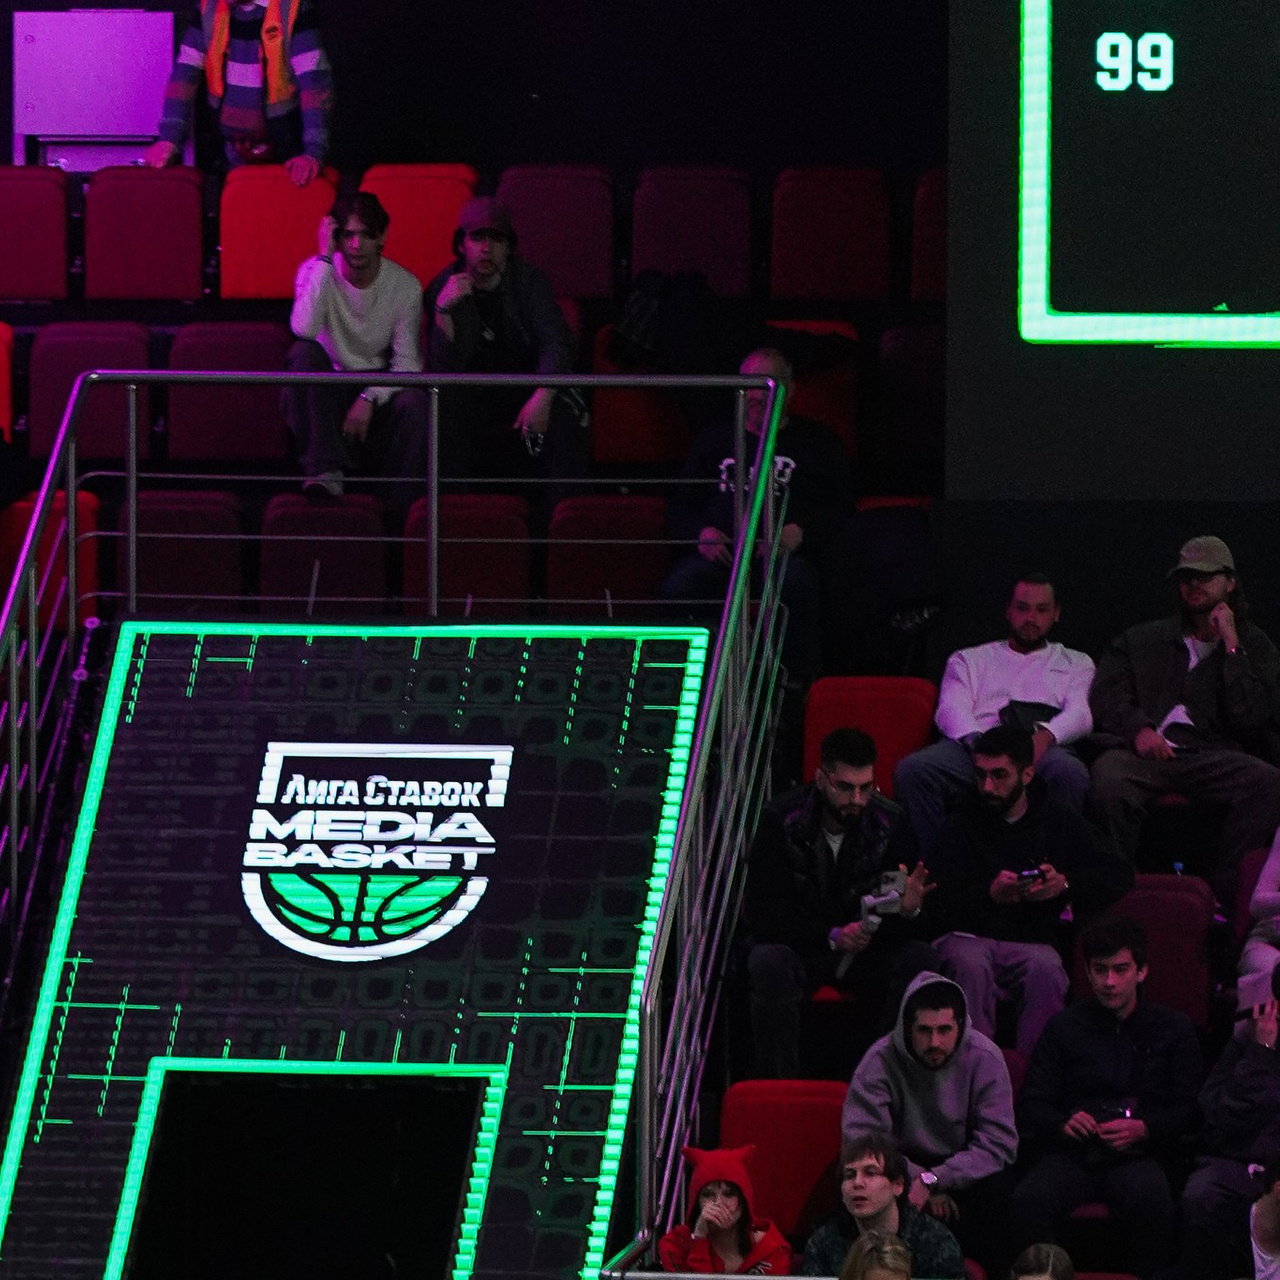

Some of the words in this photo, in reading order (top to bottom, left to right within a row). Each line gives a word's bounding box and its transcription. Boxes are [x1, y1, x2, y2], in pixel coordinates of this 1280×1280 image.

[1096, 31, 1174, 91] 99
[249, 809, 497, 843] MEDIA
[242, 842, 497, 871] BASKET
